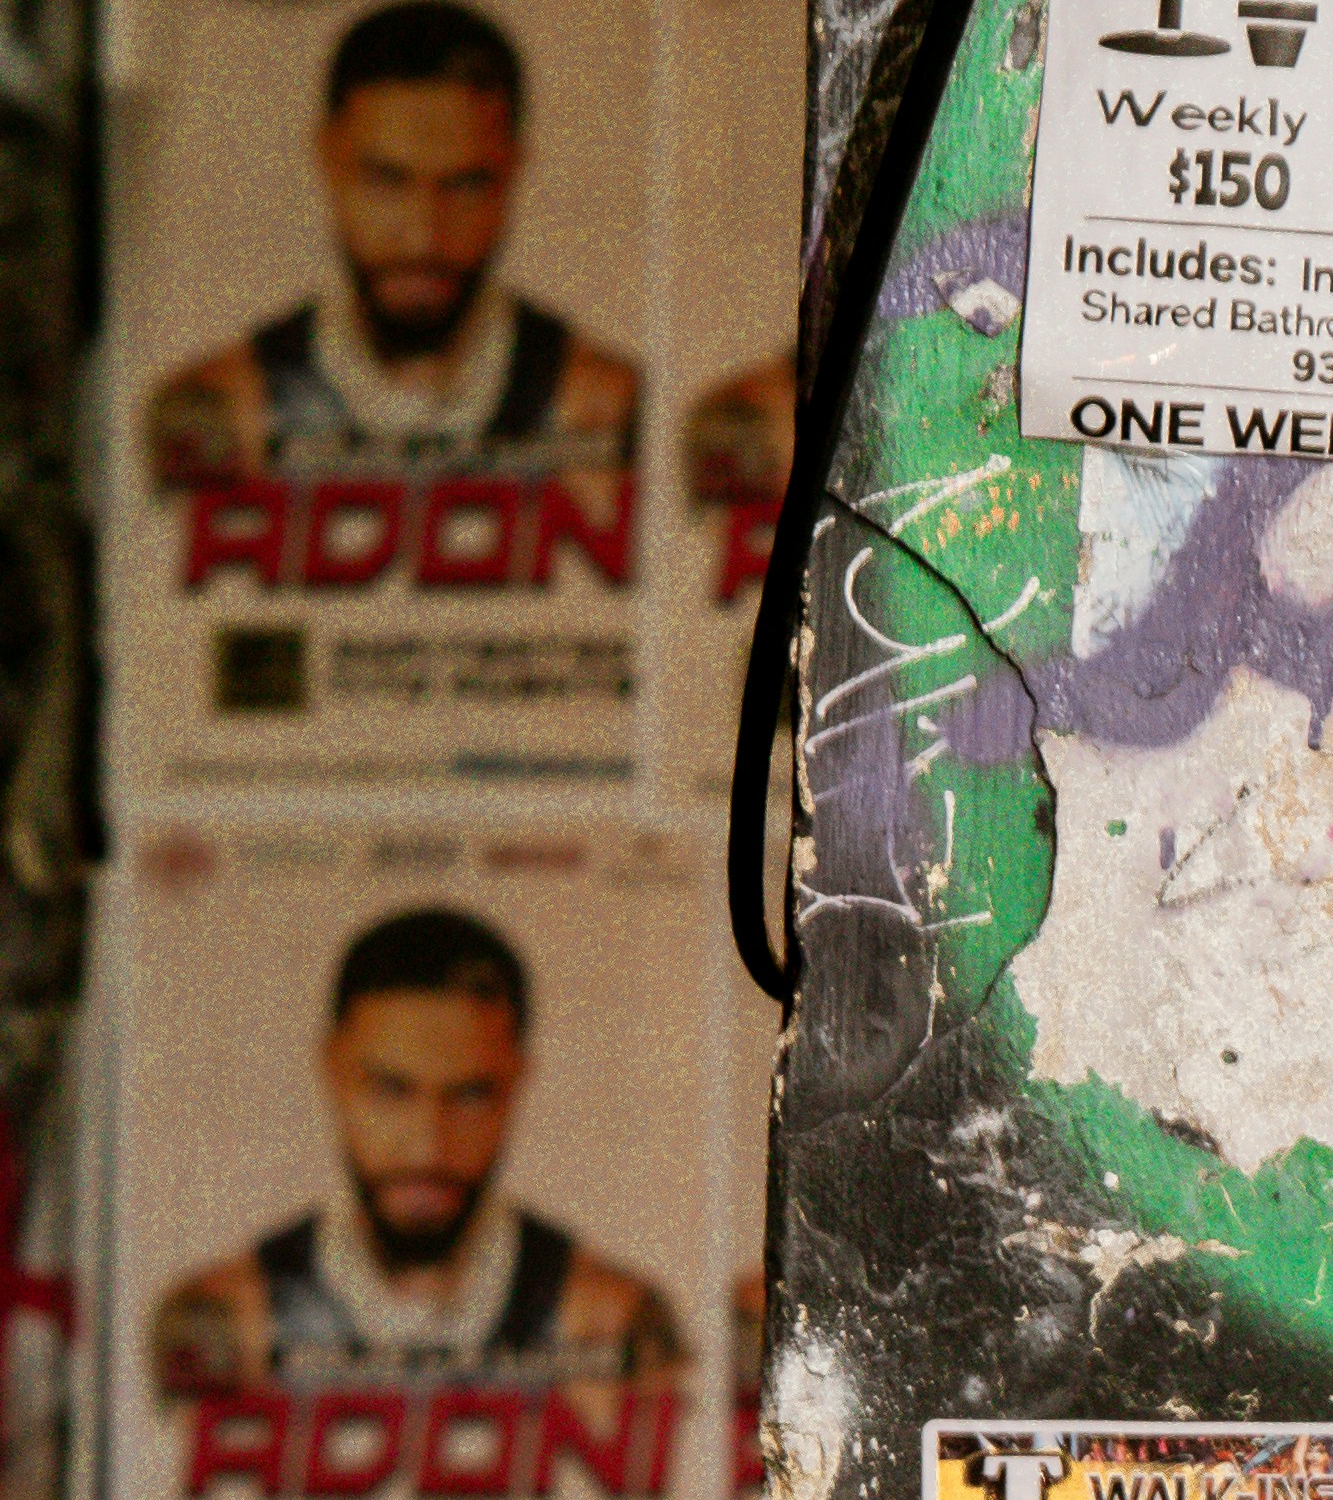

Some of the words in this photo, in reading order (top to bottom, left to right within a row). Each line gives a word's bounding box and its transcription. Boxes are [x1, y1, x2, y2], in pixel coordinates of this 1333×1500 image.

[1096, 88, 1308, 147] Weekly
[1168, 147, 1292, 212] $150
[1062, 235, 1278, 288] Includes:
[1081, 291, 1217, 330] Shared
[1070, 395, 1207, 449] ONE
